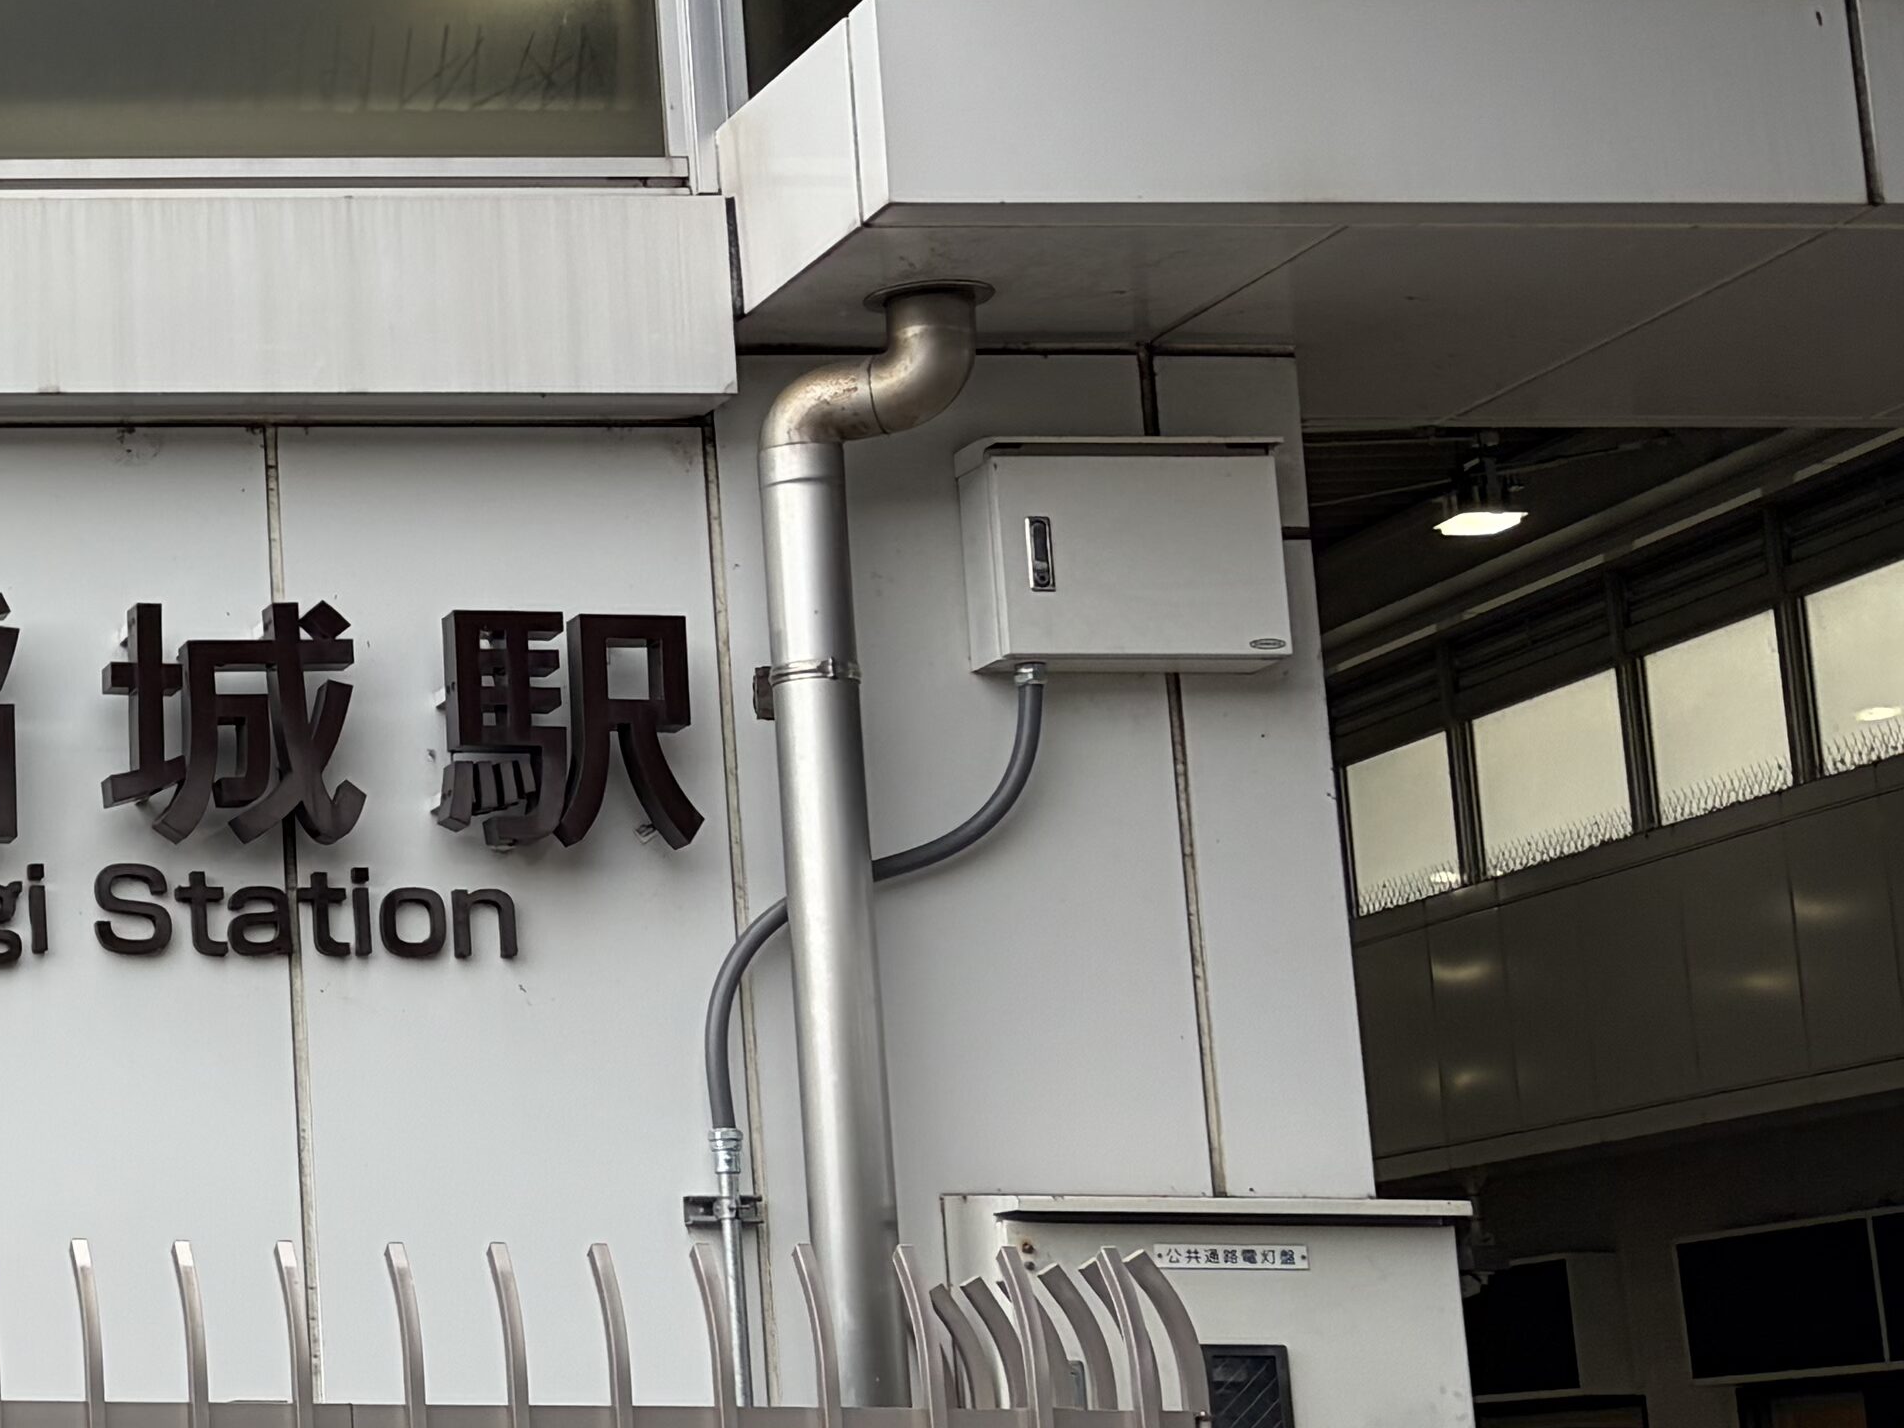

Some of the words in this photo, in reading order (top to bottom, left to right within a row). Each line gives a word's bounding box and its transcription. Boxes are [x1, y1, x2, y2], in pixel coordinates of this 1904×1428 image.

[94, 862, 522, 960] Station
[1166, 1248, 1296, 1265] 公共通路電灯盤
